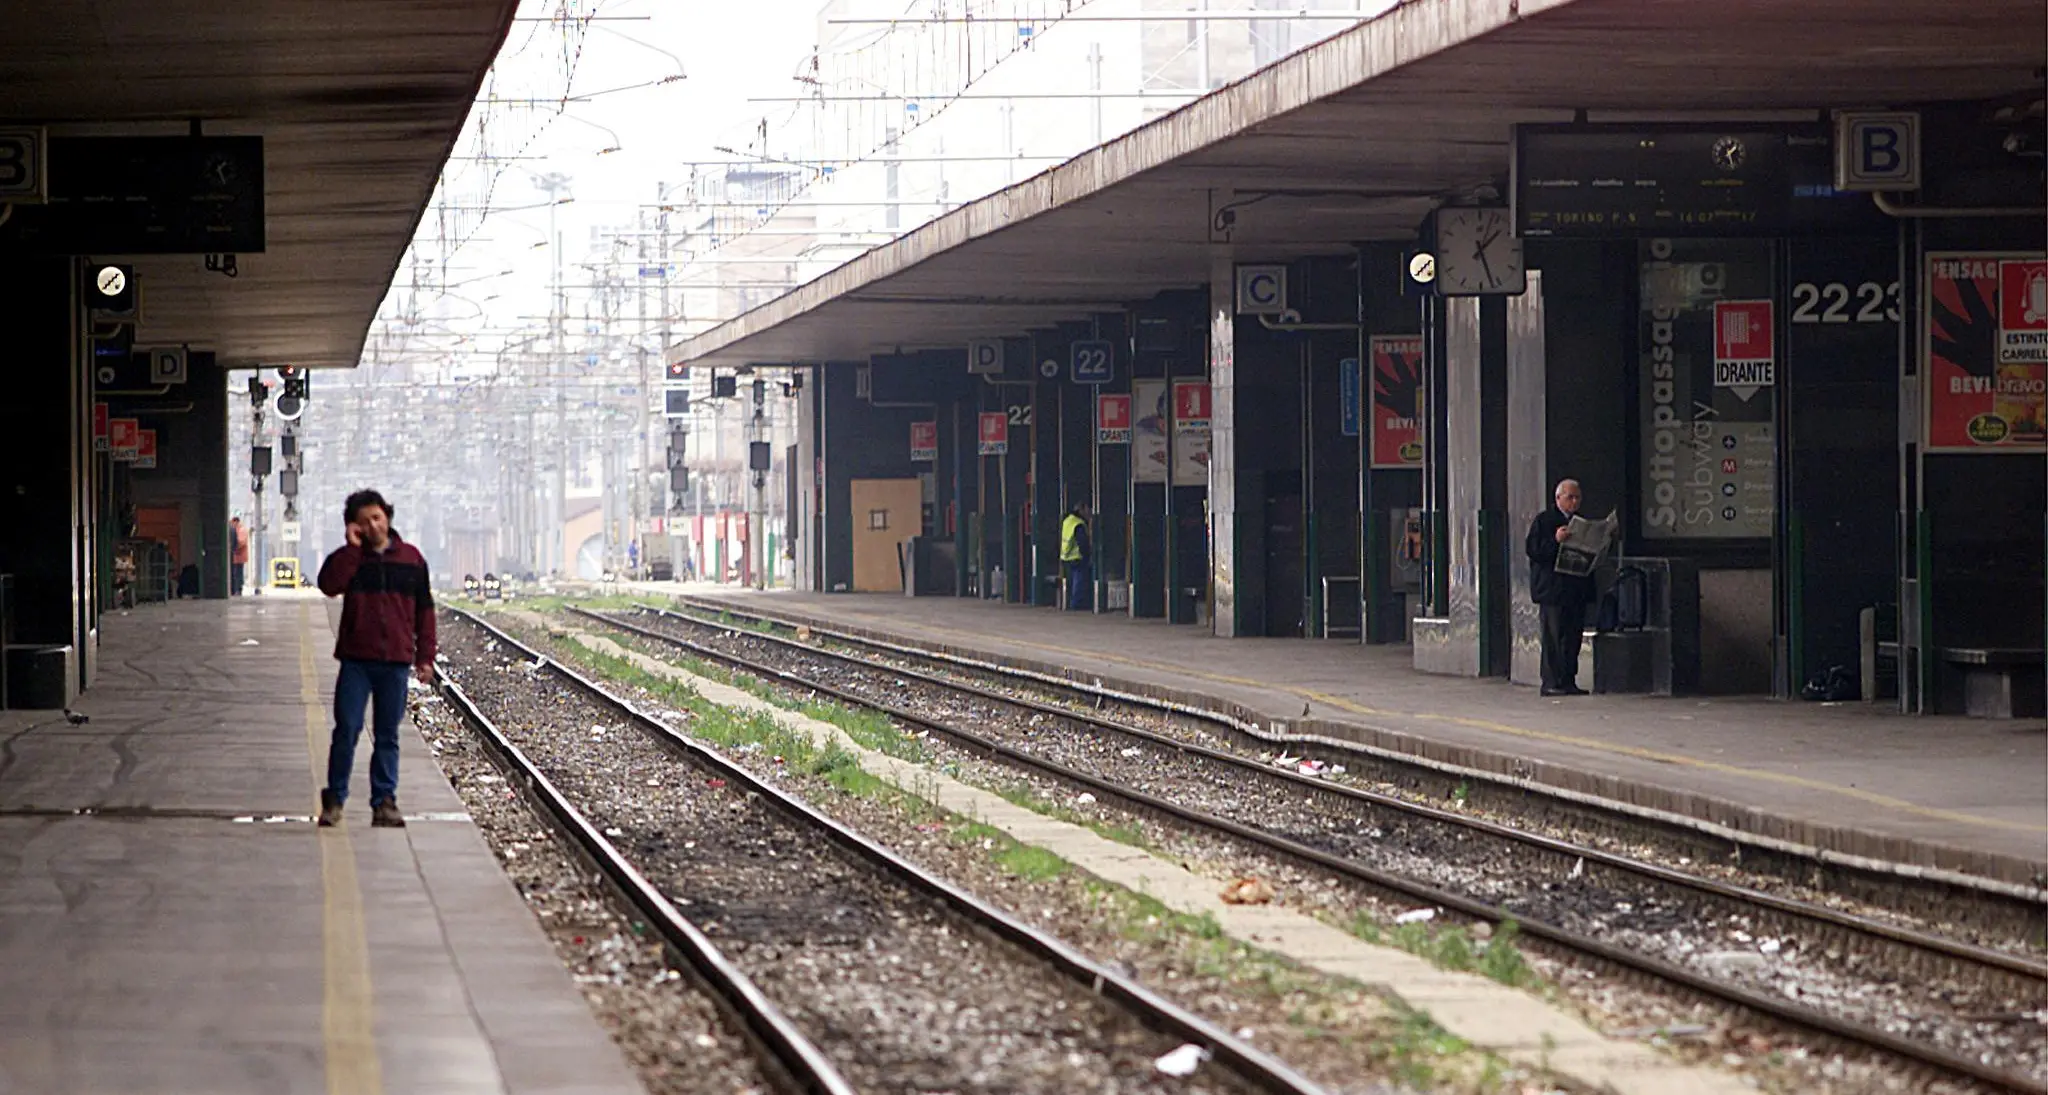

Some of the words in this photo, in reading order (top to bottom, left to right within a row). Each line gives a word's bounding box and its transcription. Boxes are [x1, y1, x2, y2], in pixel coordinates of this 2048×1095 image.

[1863, 127, 1901, 172] B
[1250, 274, 1276, 303] C
[1792, 282, 1849, 323] 22
[159, 354, 178, 374] D
[979, 345, 995, 366] D
[1078, 349, 1106, 374] 22
[1715, 361, 1772, 383] IDRANTE
[1008, 404, 1033, 426] 22
[1682, 400, 1719, 526] Subway
